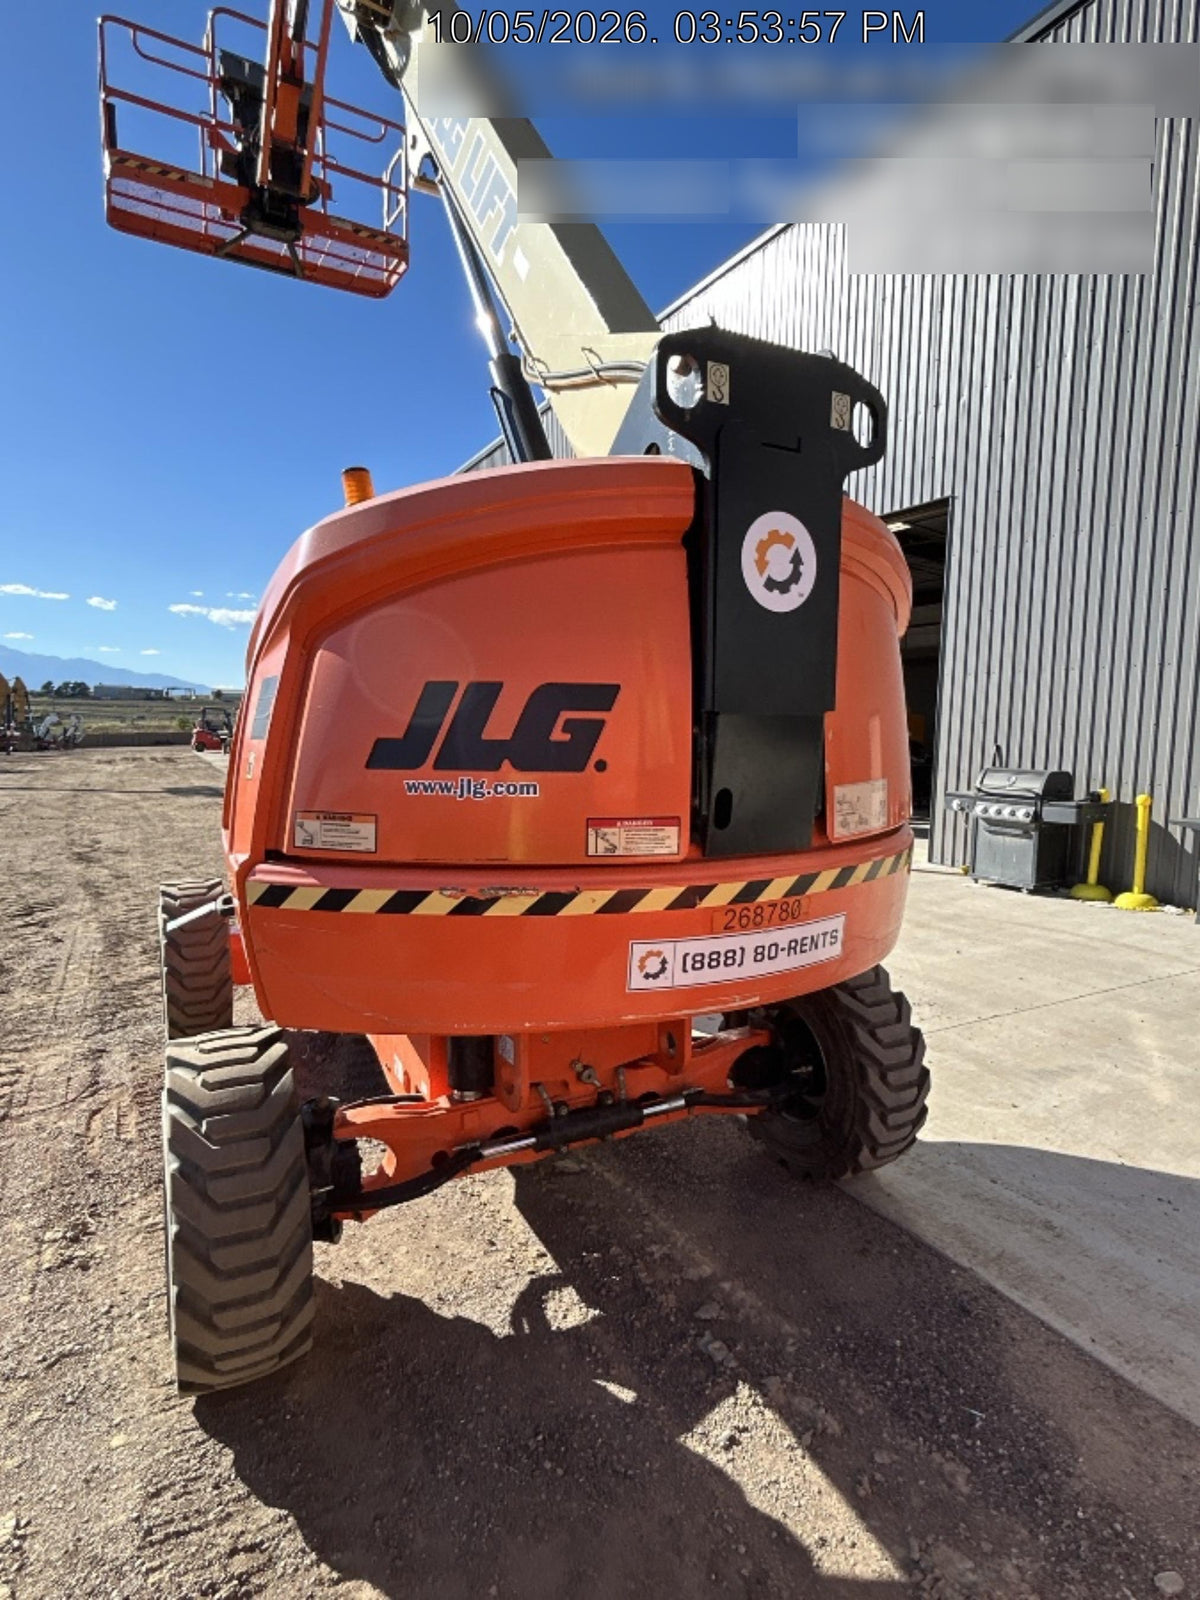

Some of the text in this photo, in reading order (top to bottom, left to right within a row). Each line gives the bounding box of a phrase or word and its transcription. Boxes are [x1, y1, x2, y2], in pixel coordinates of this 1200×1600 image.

[459, 127, 520, 268] LIFT
[404, 777, 539, 800] www.jlg.com
[723, 899, 801, 930] 268780
[681, 928, 839, 974] (888) 80-RENTS
